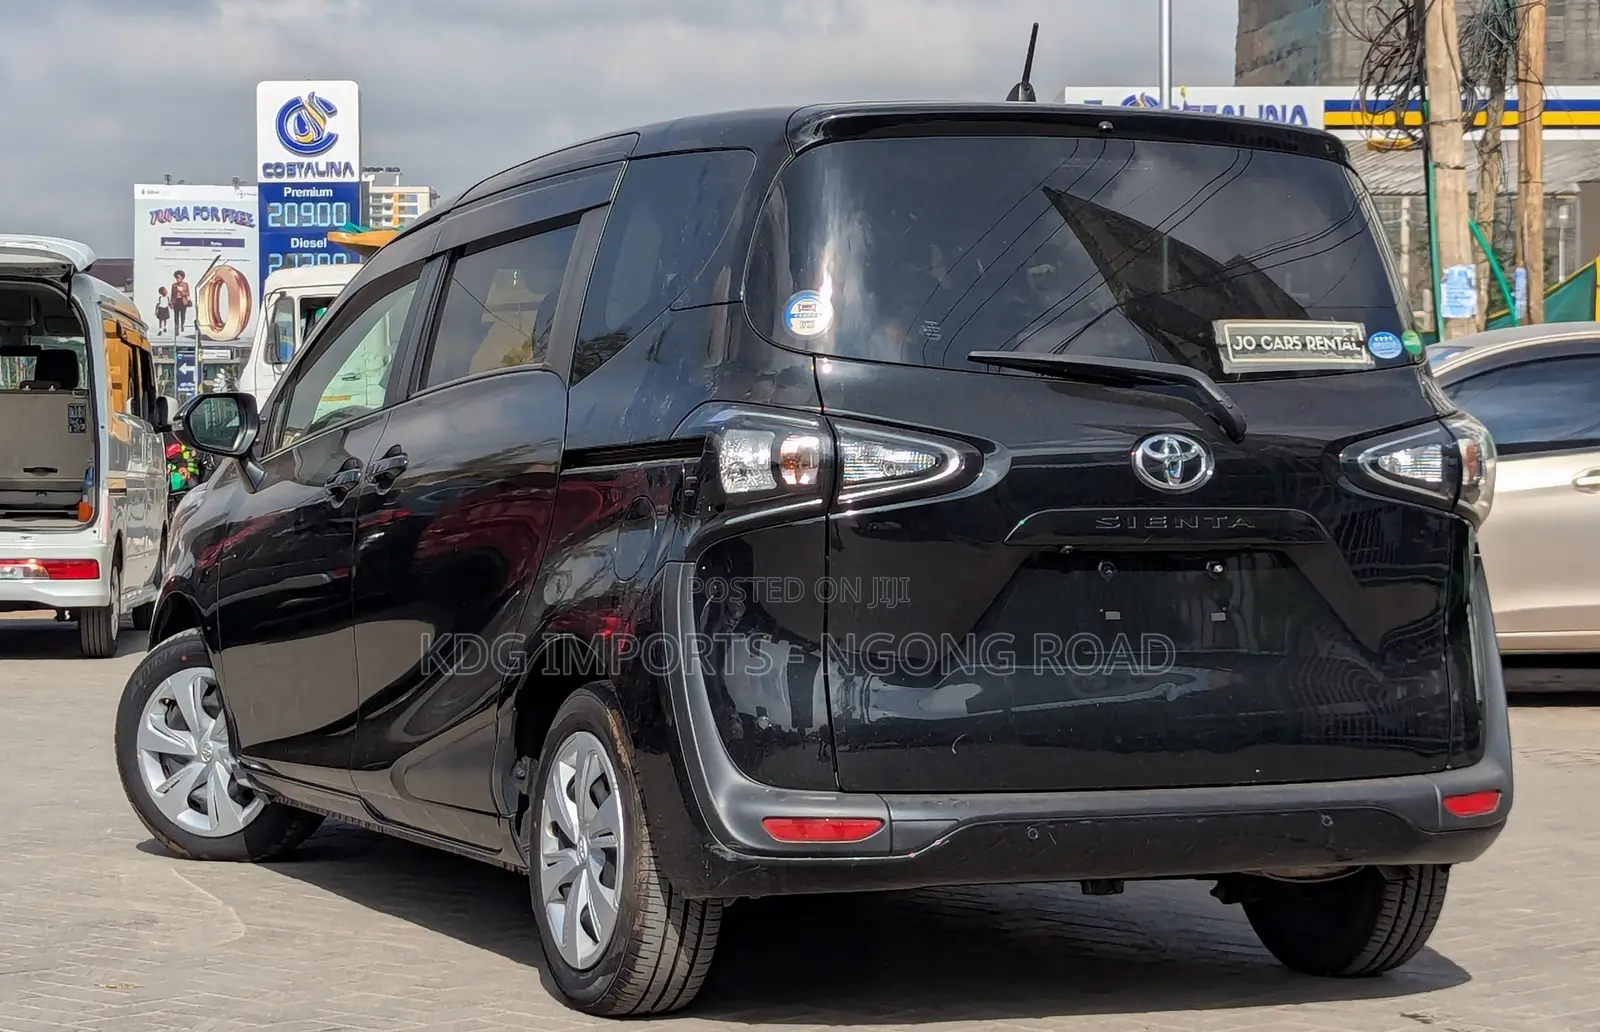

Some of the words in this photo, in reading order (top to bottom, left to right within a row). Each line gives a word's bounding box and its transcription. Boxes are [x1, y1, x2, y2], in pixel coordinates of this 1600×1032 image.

[283, 187, 333, 197] Premium
[193, 206, 220, 222] FOR
[221, 207, 256, 228] FREE
[290, 237, 327, 248] Diesel
[1232, 336, 1256, 350] JO
[1260, 335, 1301, 350] CARS
[1307, 336, 1361, 351] RENTAL
[1095, 515, 1256, 529] SIENTA
